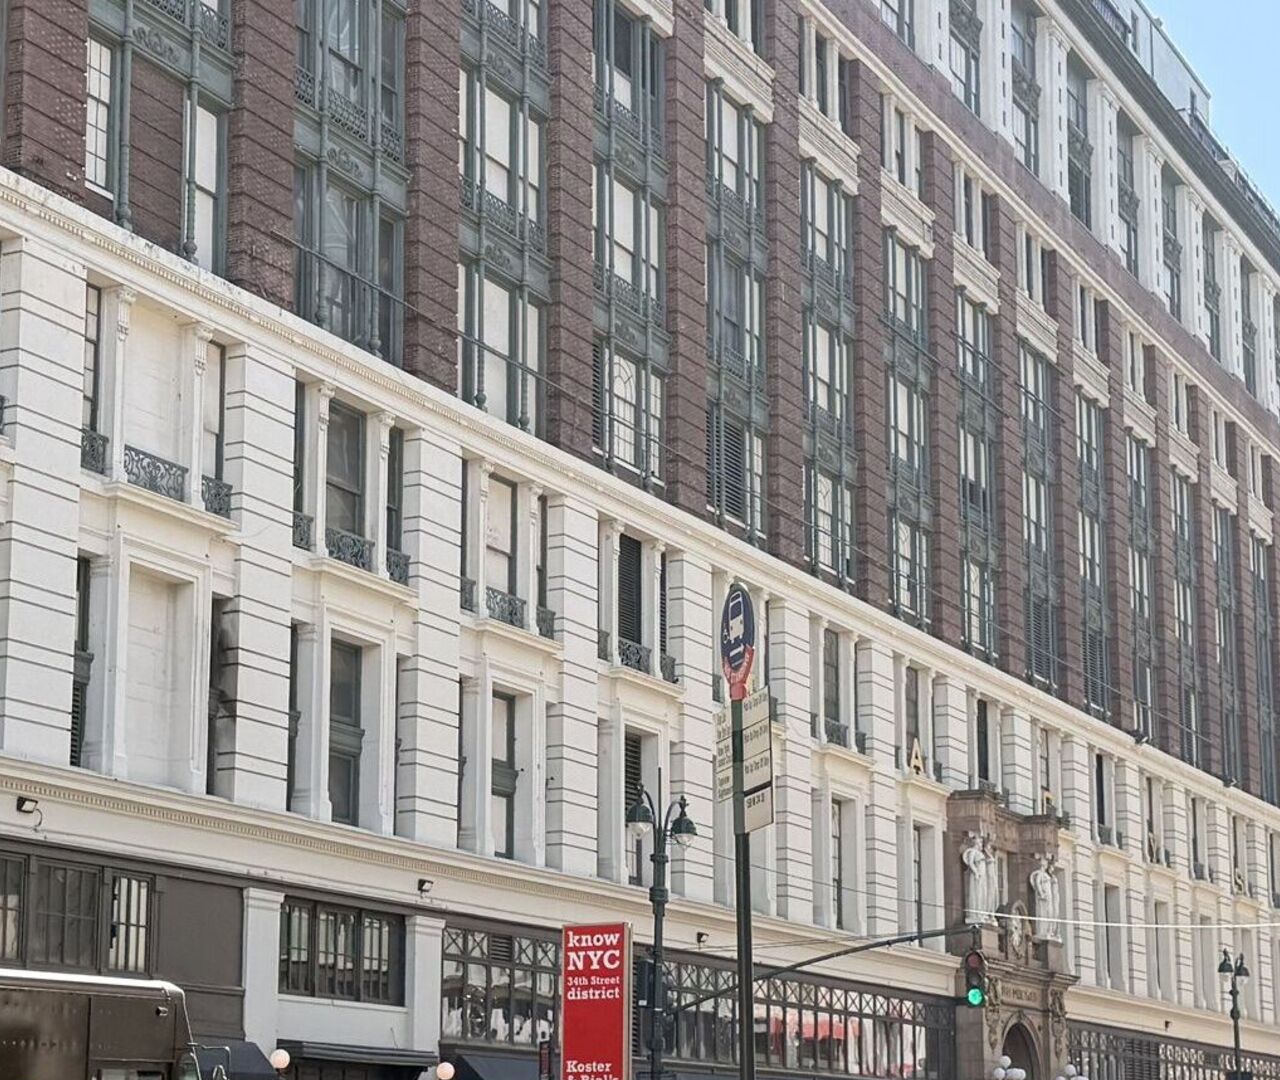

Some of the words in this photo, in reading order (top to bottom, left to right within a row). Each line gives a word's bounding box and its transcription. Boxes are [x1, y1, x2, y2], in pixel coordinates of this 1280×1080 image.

[568, 931, 620, 947] know
[568, 950, 620, 970] NYC
[567, 976, 588, 986] 34th
[590, 975, 620, 986] Street
[567, 987, 620, 1000] district
[566, 1060, 612, 1073] Koster
